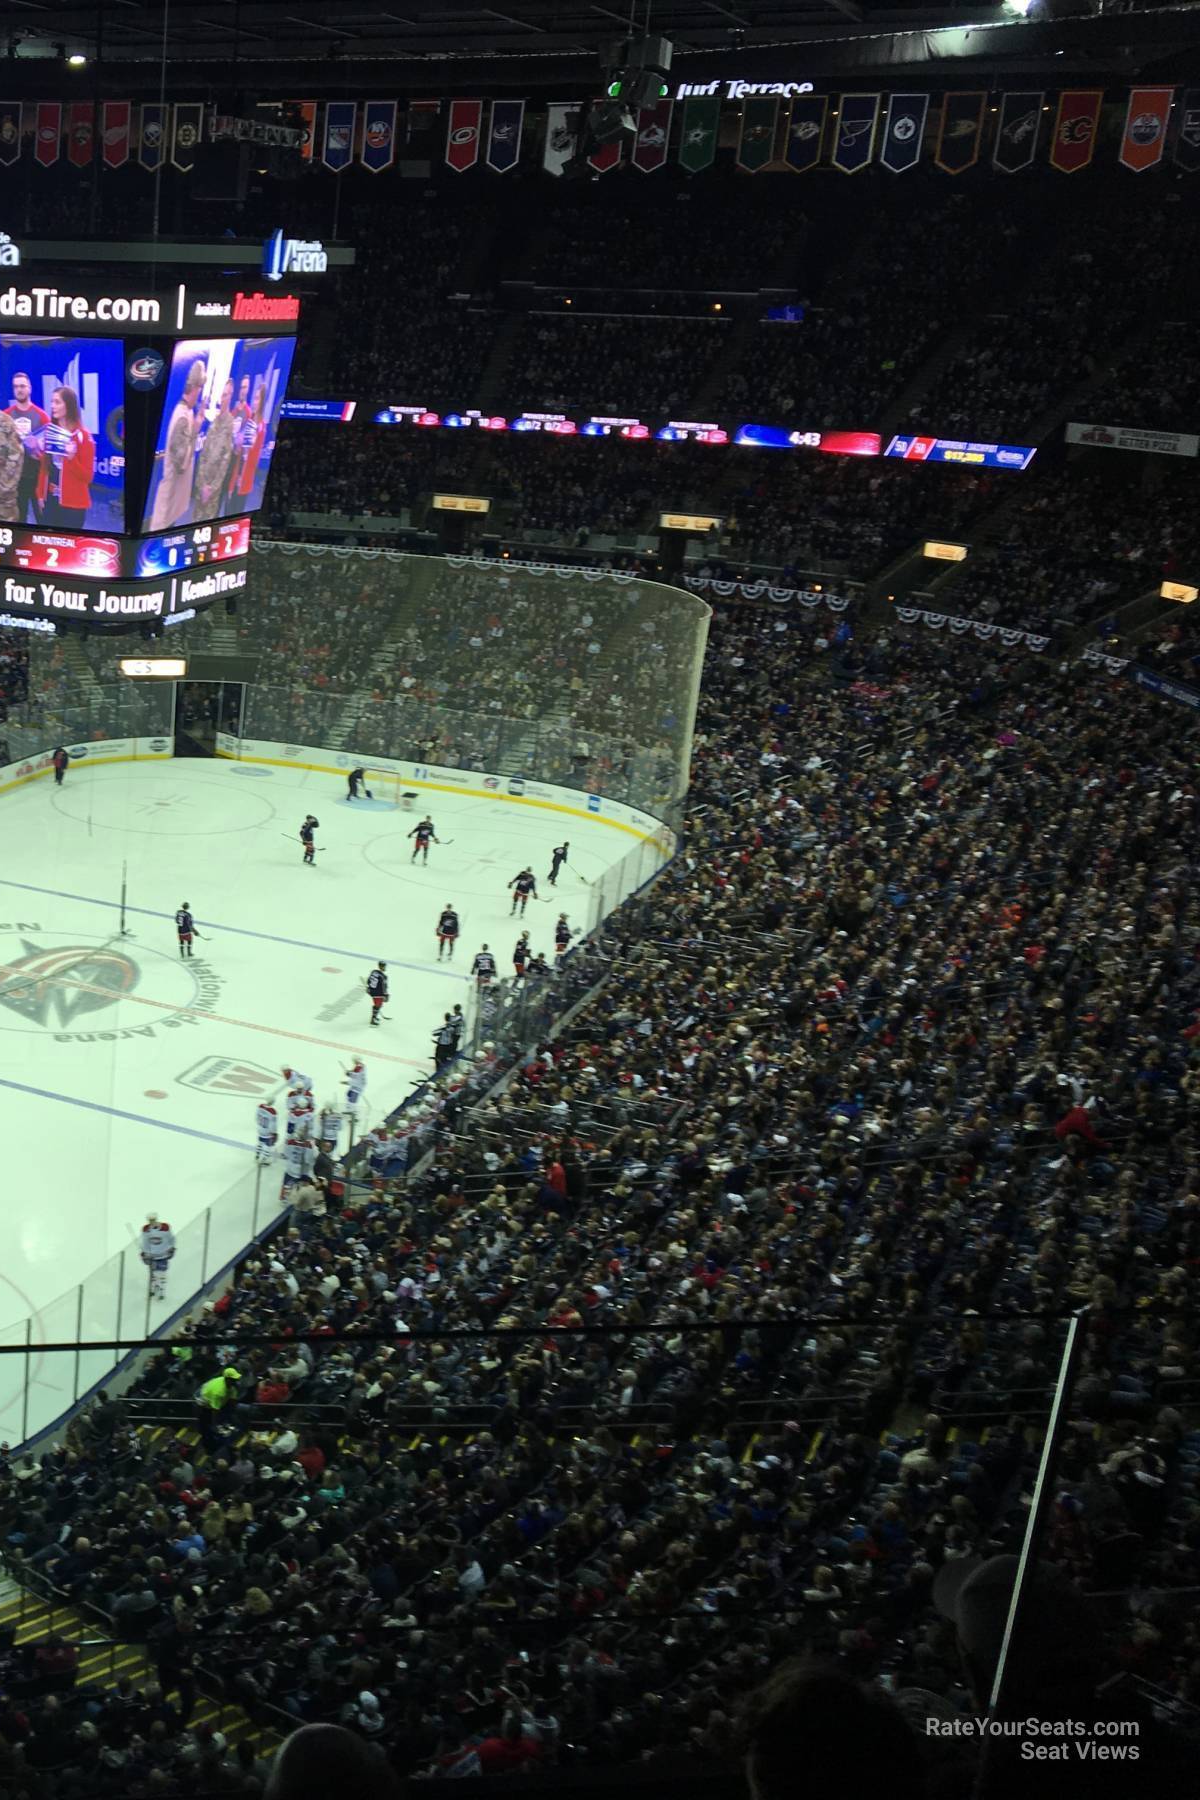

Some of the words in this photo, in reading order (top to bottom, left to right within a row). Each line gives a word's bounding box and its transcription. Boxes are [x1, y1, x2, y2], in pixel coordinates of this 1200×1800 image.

[726, 80, 814, 99] Terrace
[282, 239, 327, 272] Arena
[621, 426, 629, 436] 4
[696, 431, 708, 441] 21
[789, 431, 821, 446] 4:43
[32, 535, 76, 548] MONTREAL
[224, 536, 232, 553] 2
[46, 548, 58, 567] 2
[168, 548, 177, 566] 0
[5, 577, 36, 605] for
[40, 583, 88, 612] Your
[93, 590, 164, 615] Journey
[162, 957, 227, 1029] Nationwide
[54, 1026, 157, 1043] Arena
